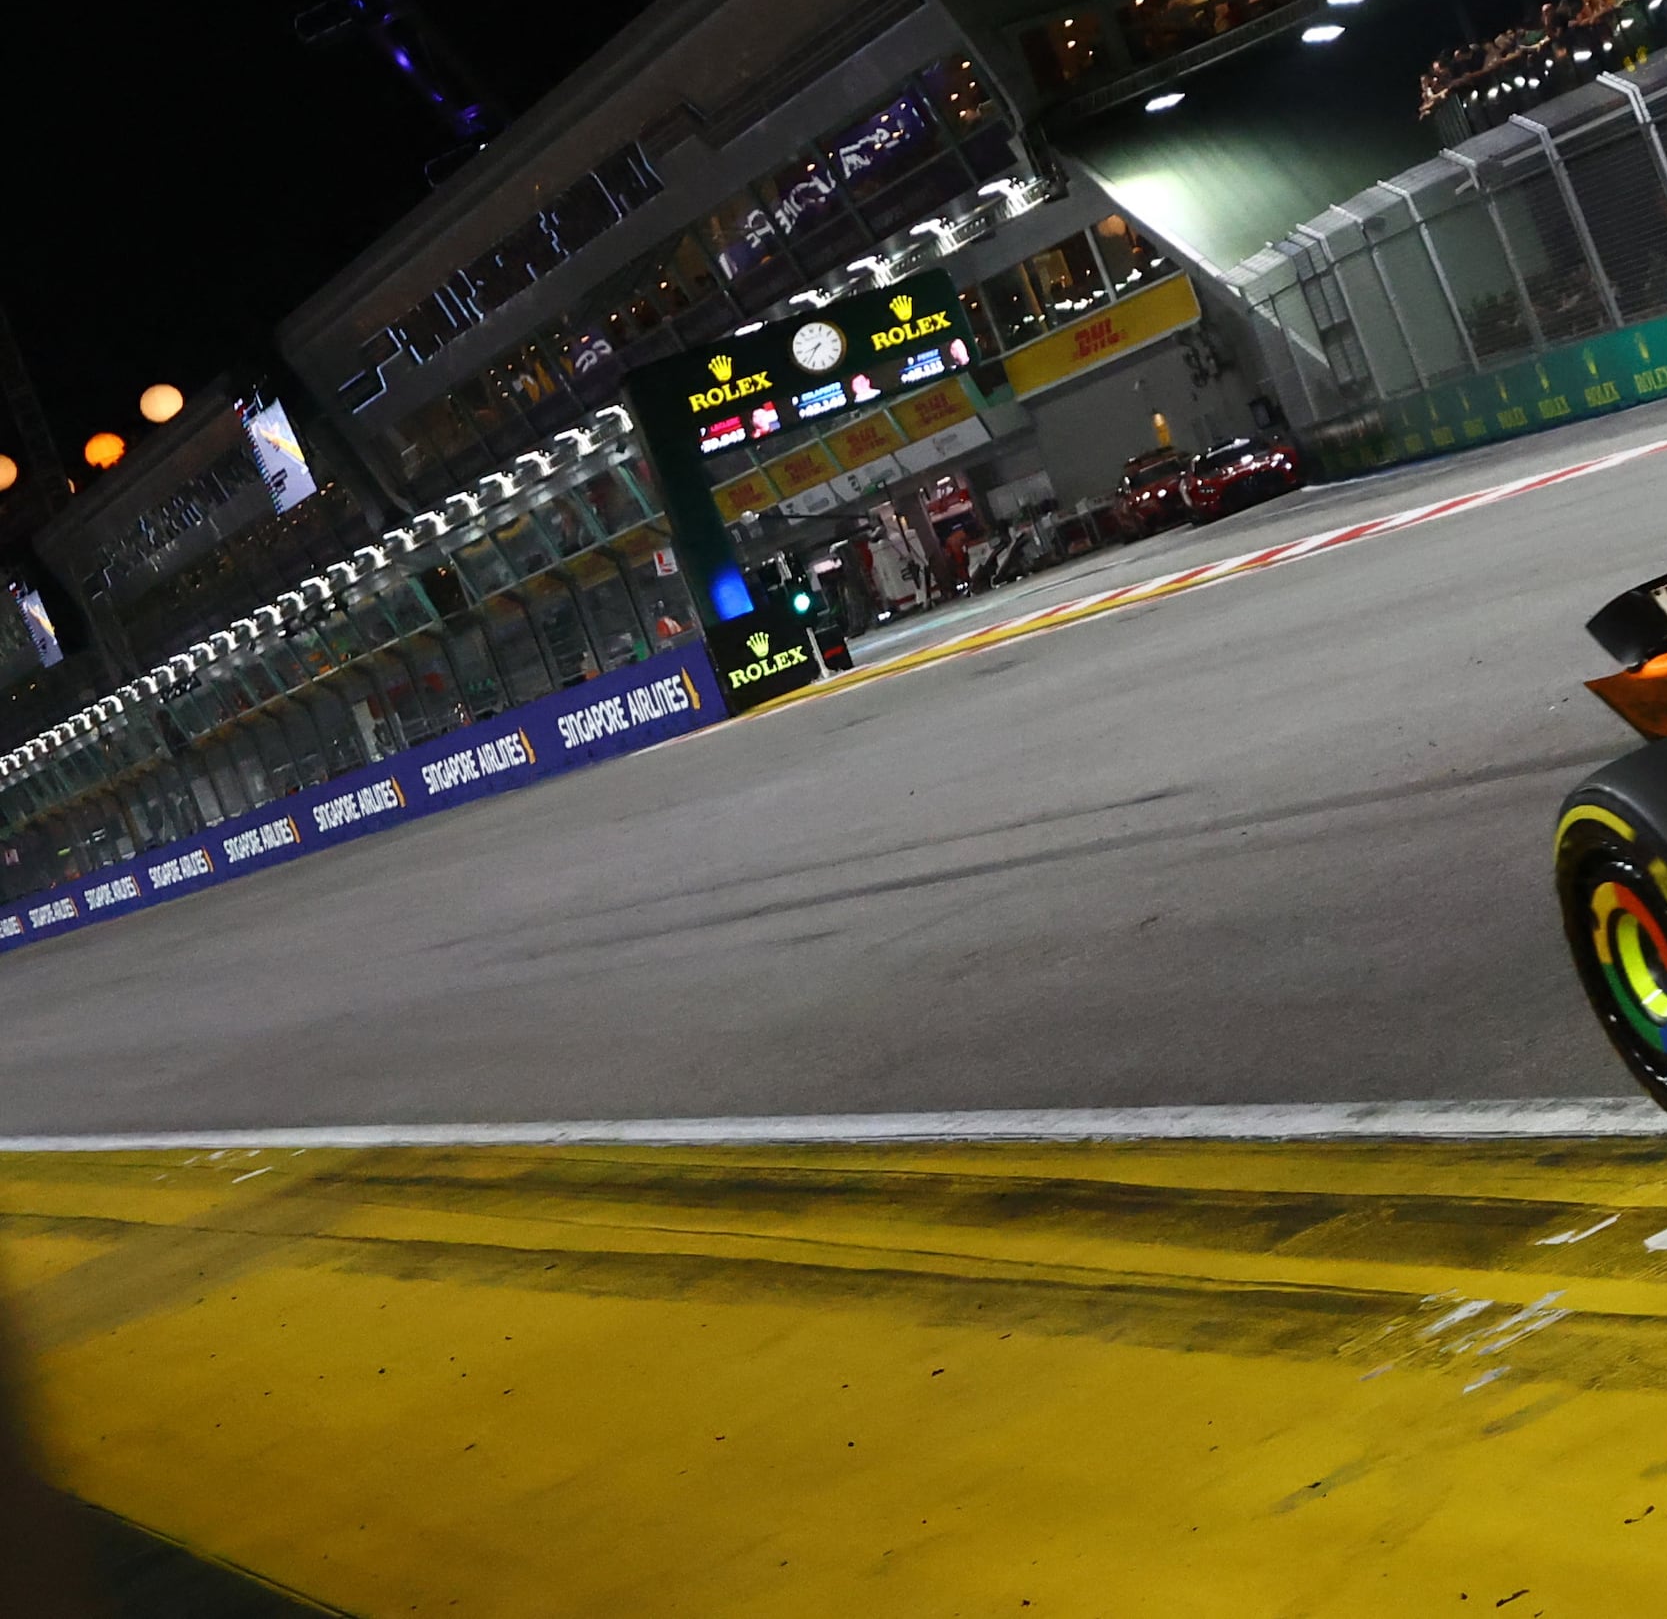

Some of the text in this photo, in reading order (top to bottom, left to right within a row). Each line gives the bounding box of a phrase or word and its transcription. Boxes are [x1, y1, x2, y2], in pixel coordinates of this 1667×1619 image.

[870, 311, 952, 351] ROLEX
[689, 371, 773, 413] ROLEX
[727, 645, 809, 689] ROLEX
[558, 674, 689, 749] SINGAPORE AIRLINES
[422, 732, 527, 795] SINGAPORE AIRLINES
[313, 780, 400, 832] SINGAPORE AIRLINES
